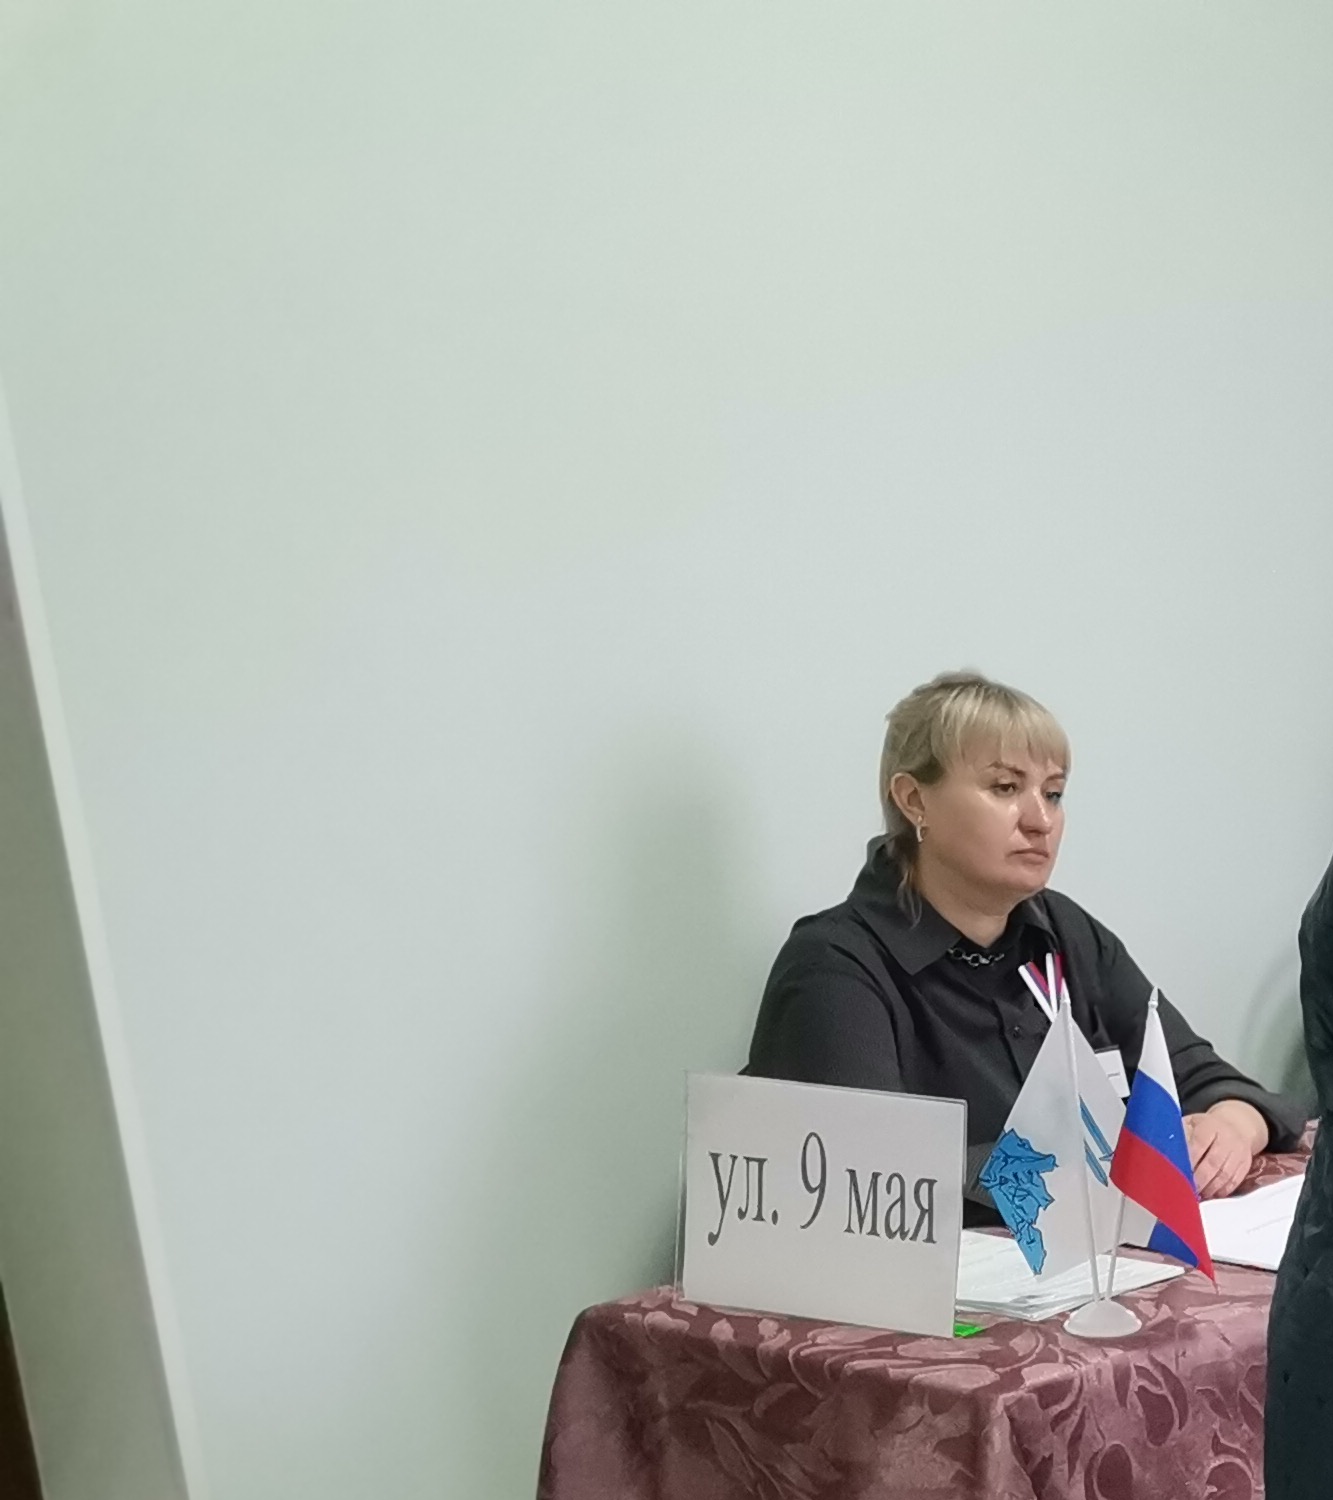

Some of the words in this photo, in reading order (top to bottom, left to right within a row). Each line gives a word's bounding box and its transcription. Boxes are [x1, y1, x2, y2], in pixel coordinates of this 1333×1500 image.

[707, 1150, 779, 1246] ул.
[799, 1131, 828, 1230] 9
[843, 1167, 939, 1245] мая
